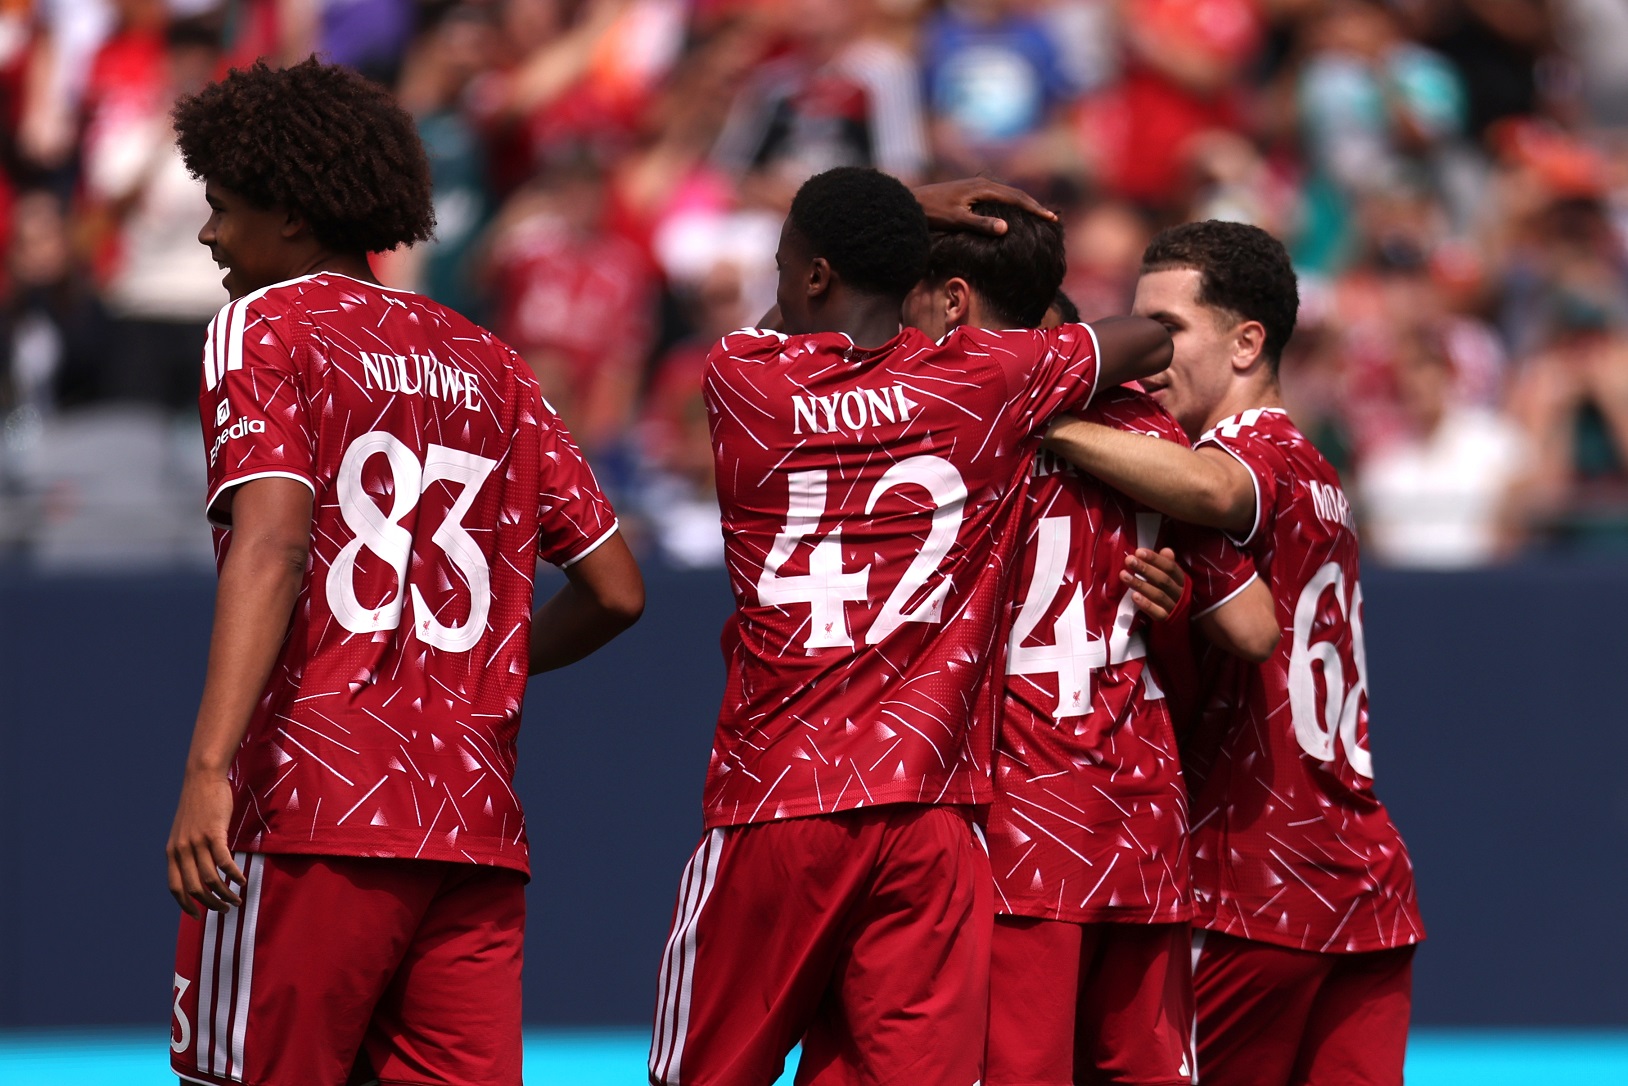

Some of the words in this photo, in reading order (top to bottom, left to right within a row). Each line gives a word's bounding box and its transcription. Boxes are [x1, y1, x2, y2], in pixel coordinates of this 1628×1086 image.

[359, 350, 481, 412] NDUKWE
[791, 385, 910, 434] NYONI
[210, 416, 265, 468] Epedia
[325, 430, 498, 653] 83
[757, 455, 968, 649] 42
